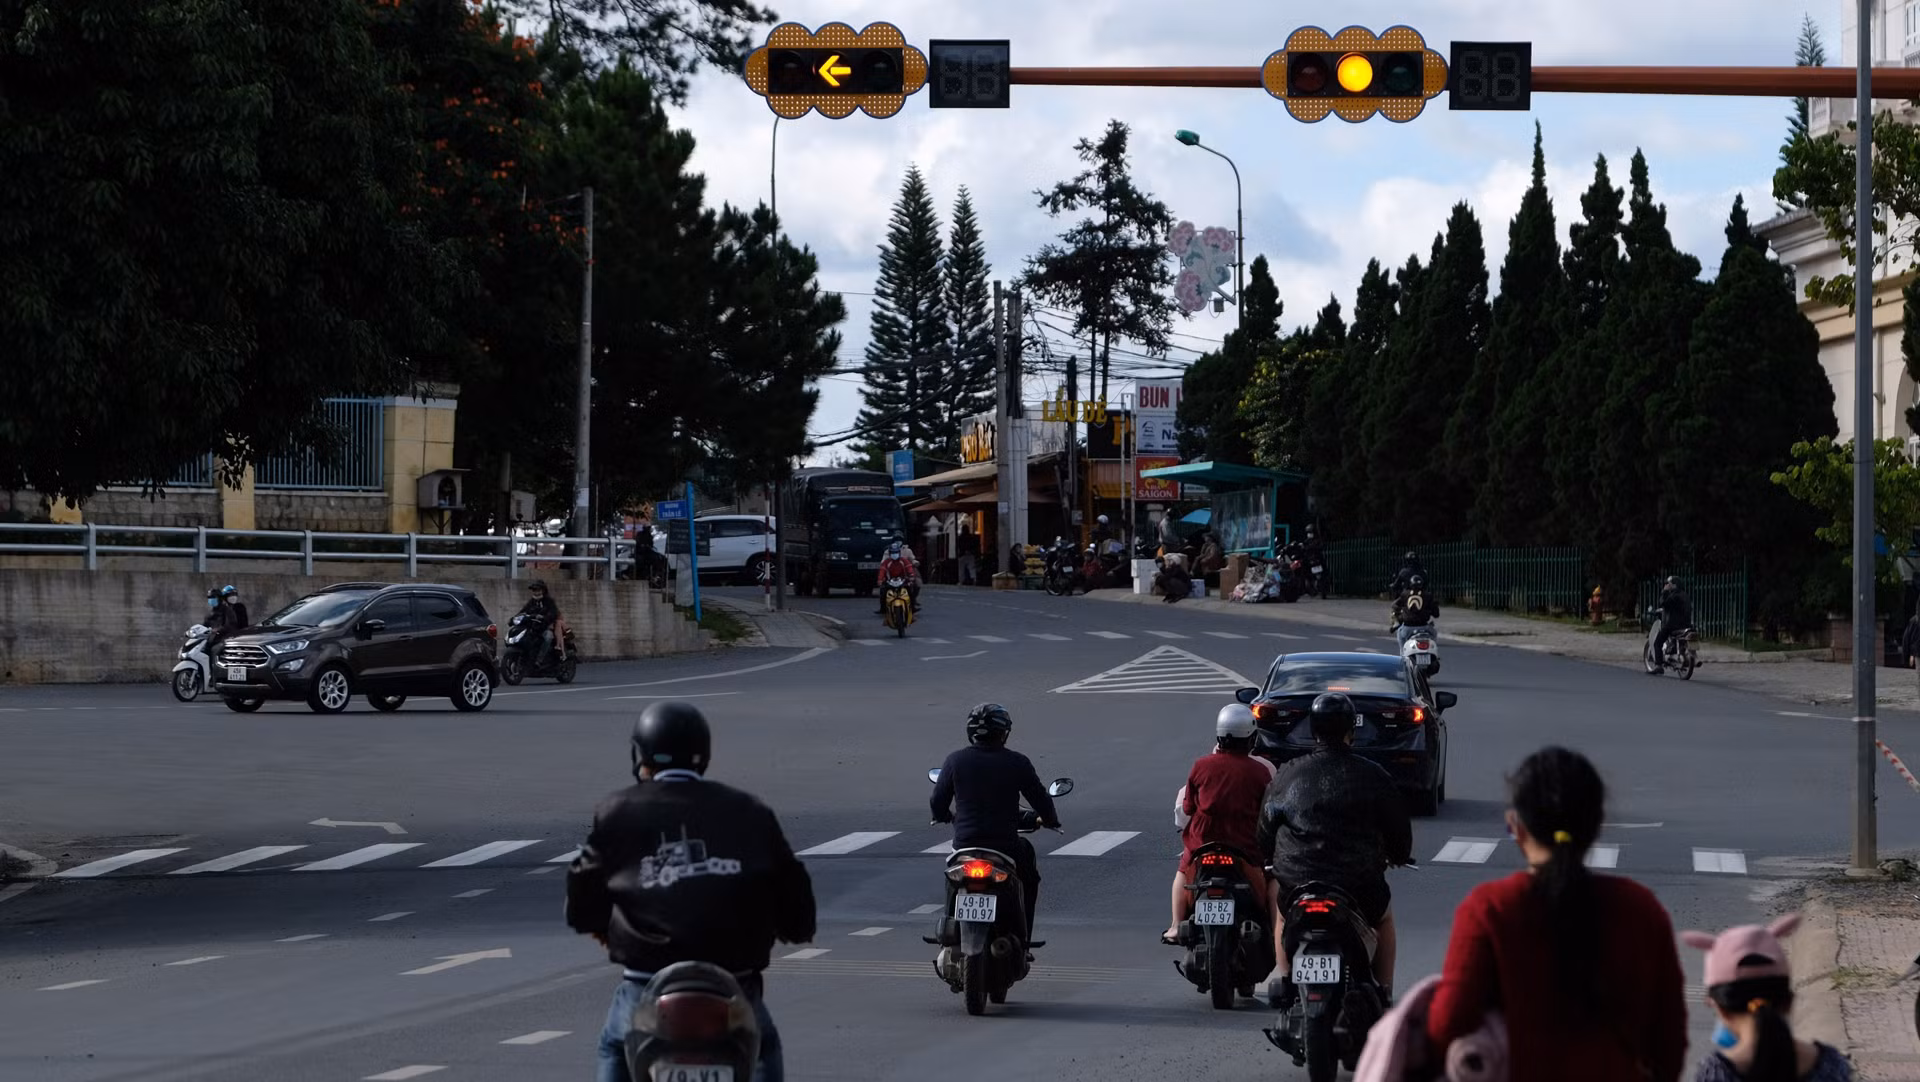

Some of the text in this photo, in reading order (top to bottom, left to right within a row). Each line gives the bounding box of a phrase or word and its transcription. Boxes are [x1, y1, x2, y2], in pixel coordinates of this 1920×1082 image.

[1138, 489, 1173, 498] SAIGON
[963, 896, 989, 908] 49-B1
[1203, 902, 1228, 912] 18-B2
[958, 908, 993, 920] 810.97
[1197, 913, 1231, 923] 402.97
[1301, 957, 1331, 969] 49-B1
[1296, 970, 1335, 981] 941.91
